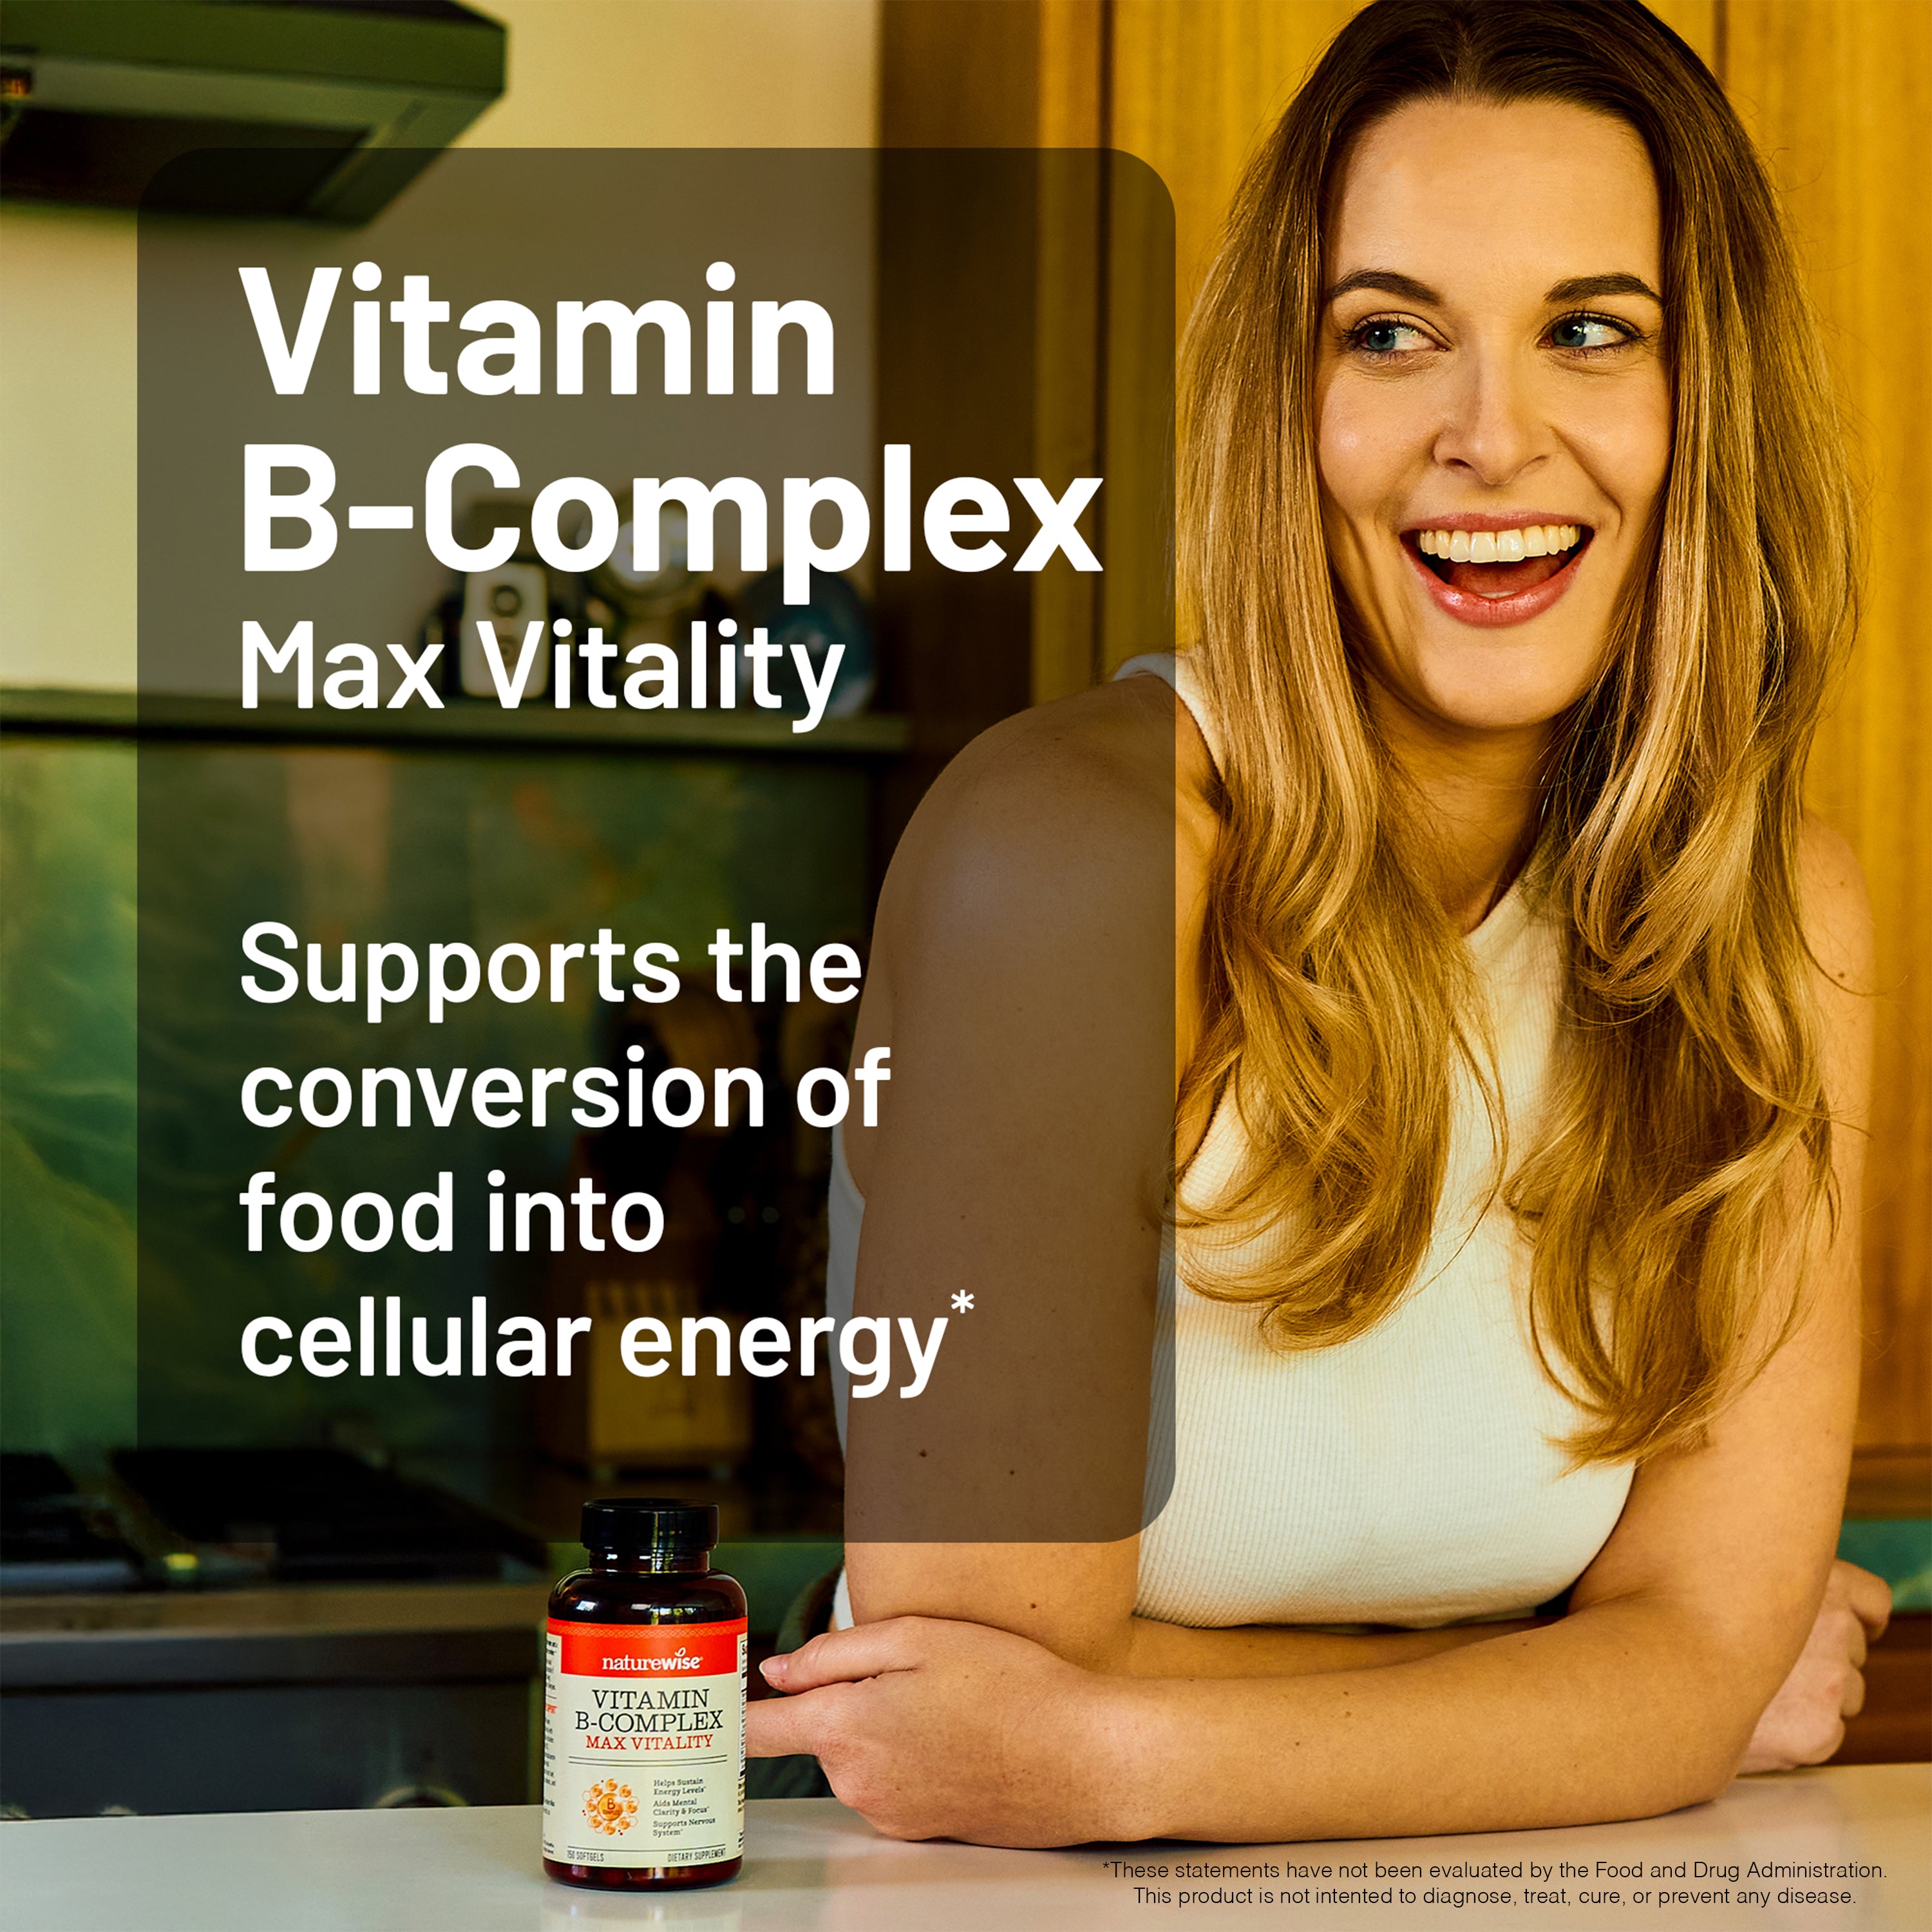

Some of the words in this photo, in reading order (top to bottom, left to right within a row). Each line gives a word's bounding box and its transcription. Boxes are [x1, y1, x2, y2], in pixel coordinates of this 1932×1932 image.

[592, 1689, 710, 1709] VITAMIN
[575, 1710, 724, 1732] B-COMPLEX
[585, 1735, 627, 1750] MAX
[630, 1734, 713, 1750] VITALITY
[654, 1779, 675, 1788] Helps
[677, 1777, 703, 1786] Sustain
[672, 1798, 697, 1806] Mental
[653, 1808, 679, 1817] Clarity
[653, 1821, 687, 1829] Supports
[688, 1817, 715, 1826] Nervous
[576, 1851, 604, 1862] SOFTGELS
[668, 1853, 692, 1862] DIETARY
[694, 1848, 726, 1861] SUPPLEMENT
